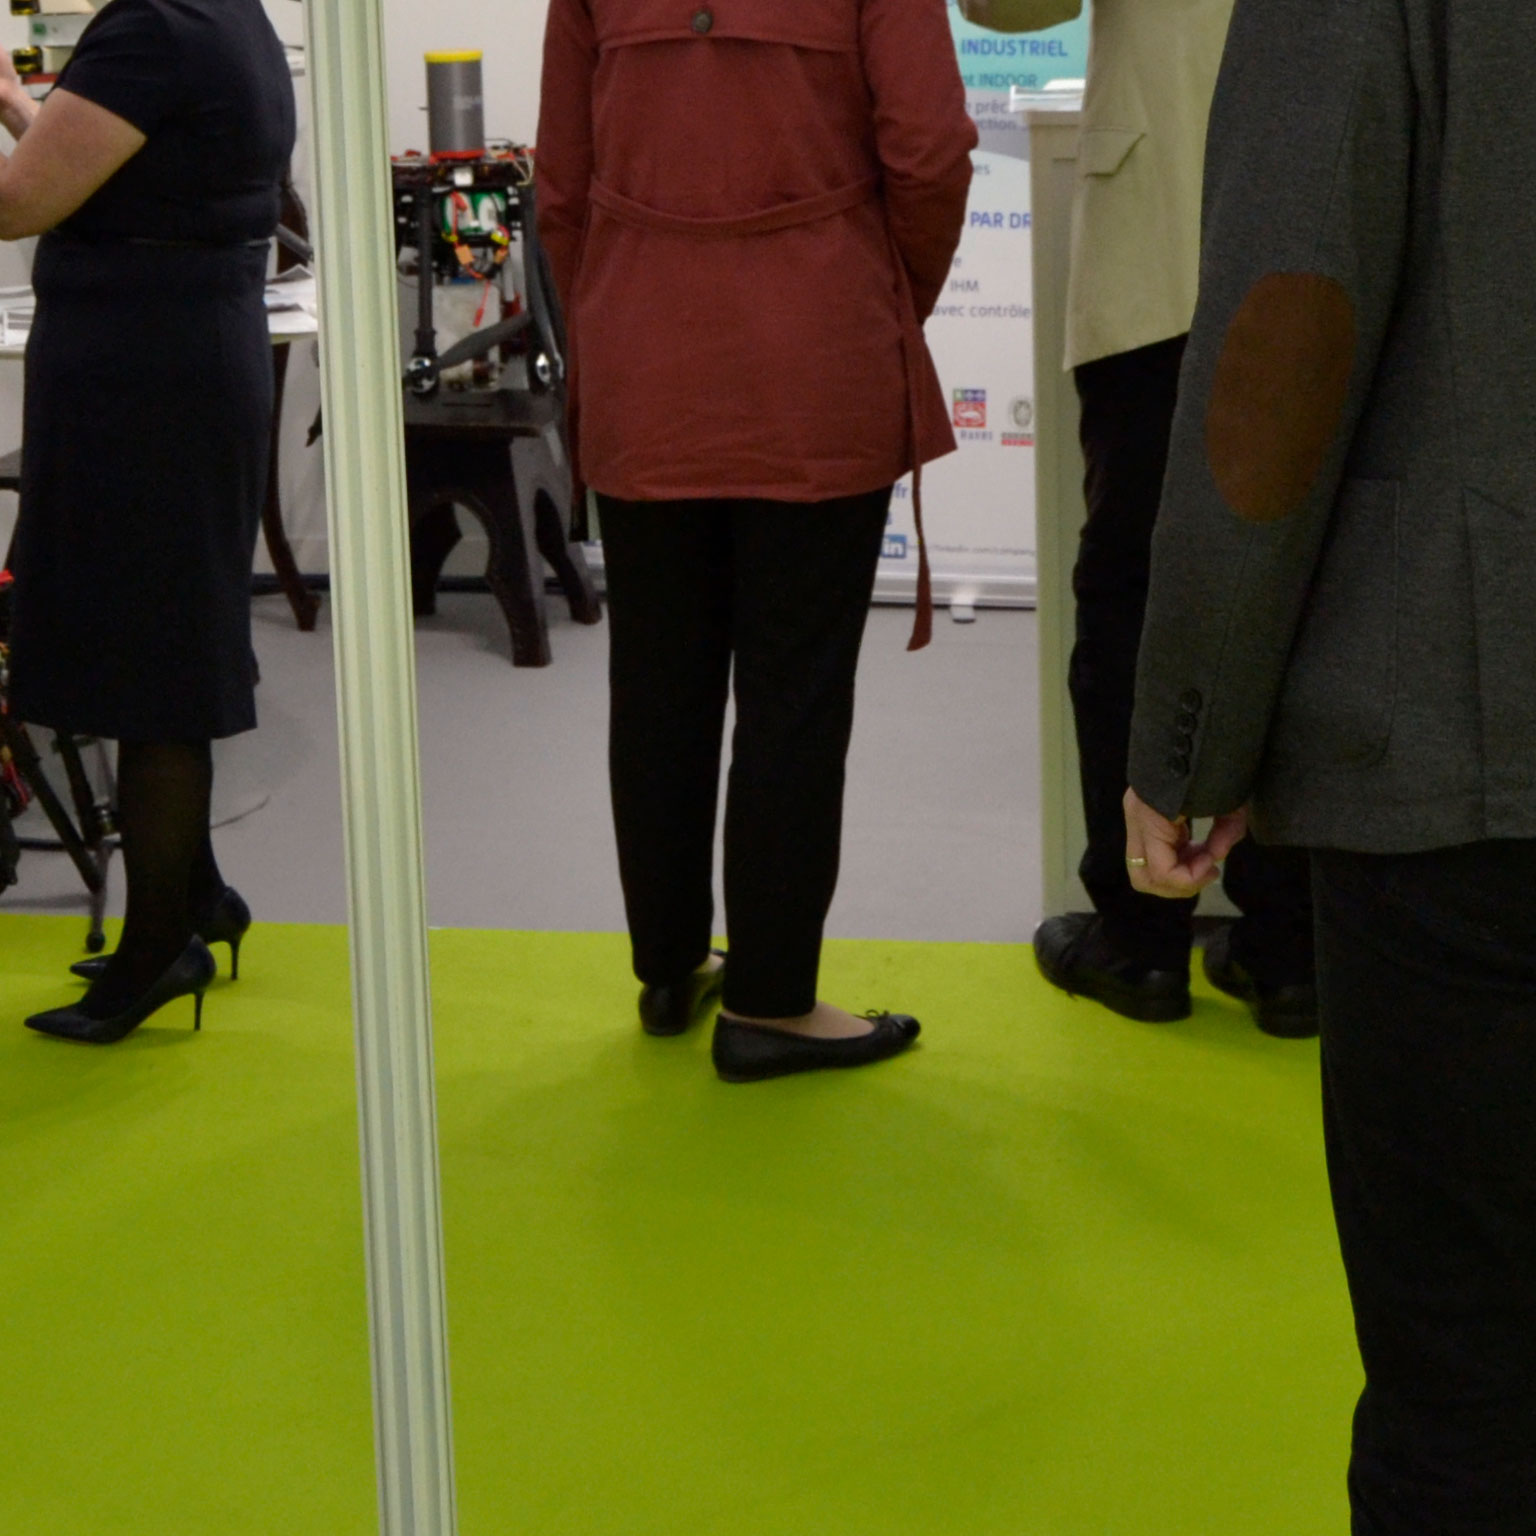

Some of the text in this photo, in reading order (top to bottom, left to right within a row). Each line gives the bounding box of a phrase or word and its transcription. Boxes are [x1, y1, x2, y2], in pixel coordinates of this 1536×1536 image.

[961, 38, 1069, 57] INDUSTRIEL
[970, 211, 1004, 228] PAR
[950, 279, 980, 293] IHM
